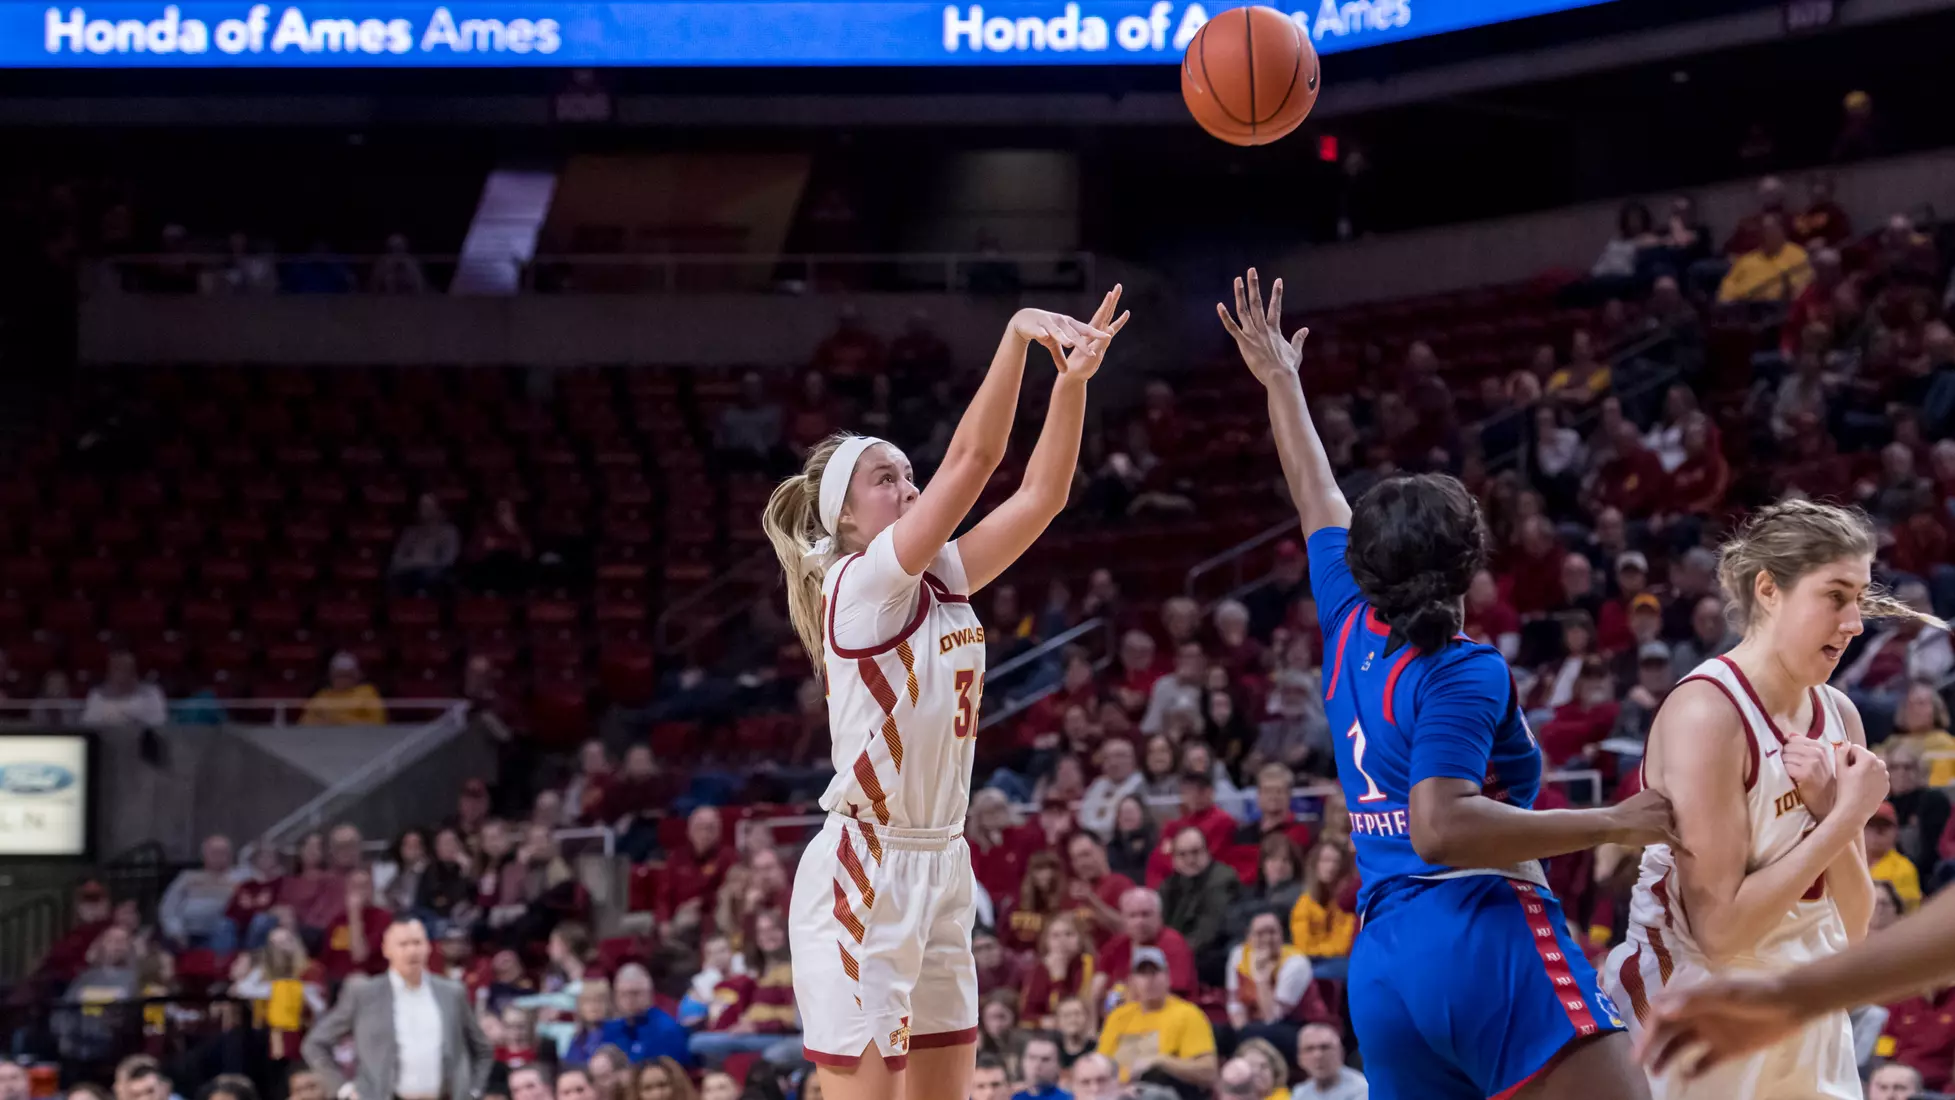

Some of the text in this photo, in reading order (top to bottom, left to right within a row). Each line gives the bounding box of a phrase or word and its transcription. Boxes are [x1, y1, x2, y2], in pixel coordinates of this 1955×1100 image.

[45, 3, 561, 54] Honda of Ames Ames
[943, 1, 1109, 52] Honda
[1116, 1, 1173, 52] of
[1313, 0, 1411, 41] Ames
[1347, 716, 1387, 803] 1
